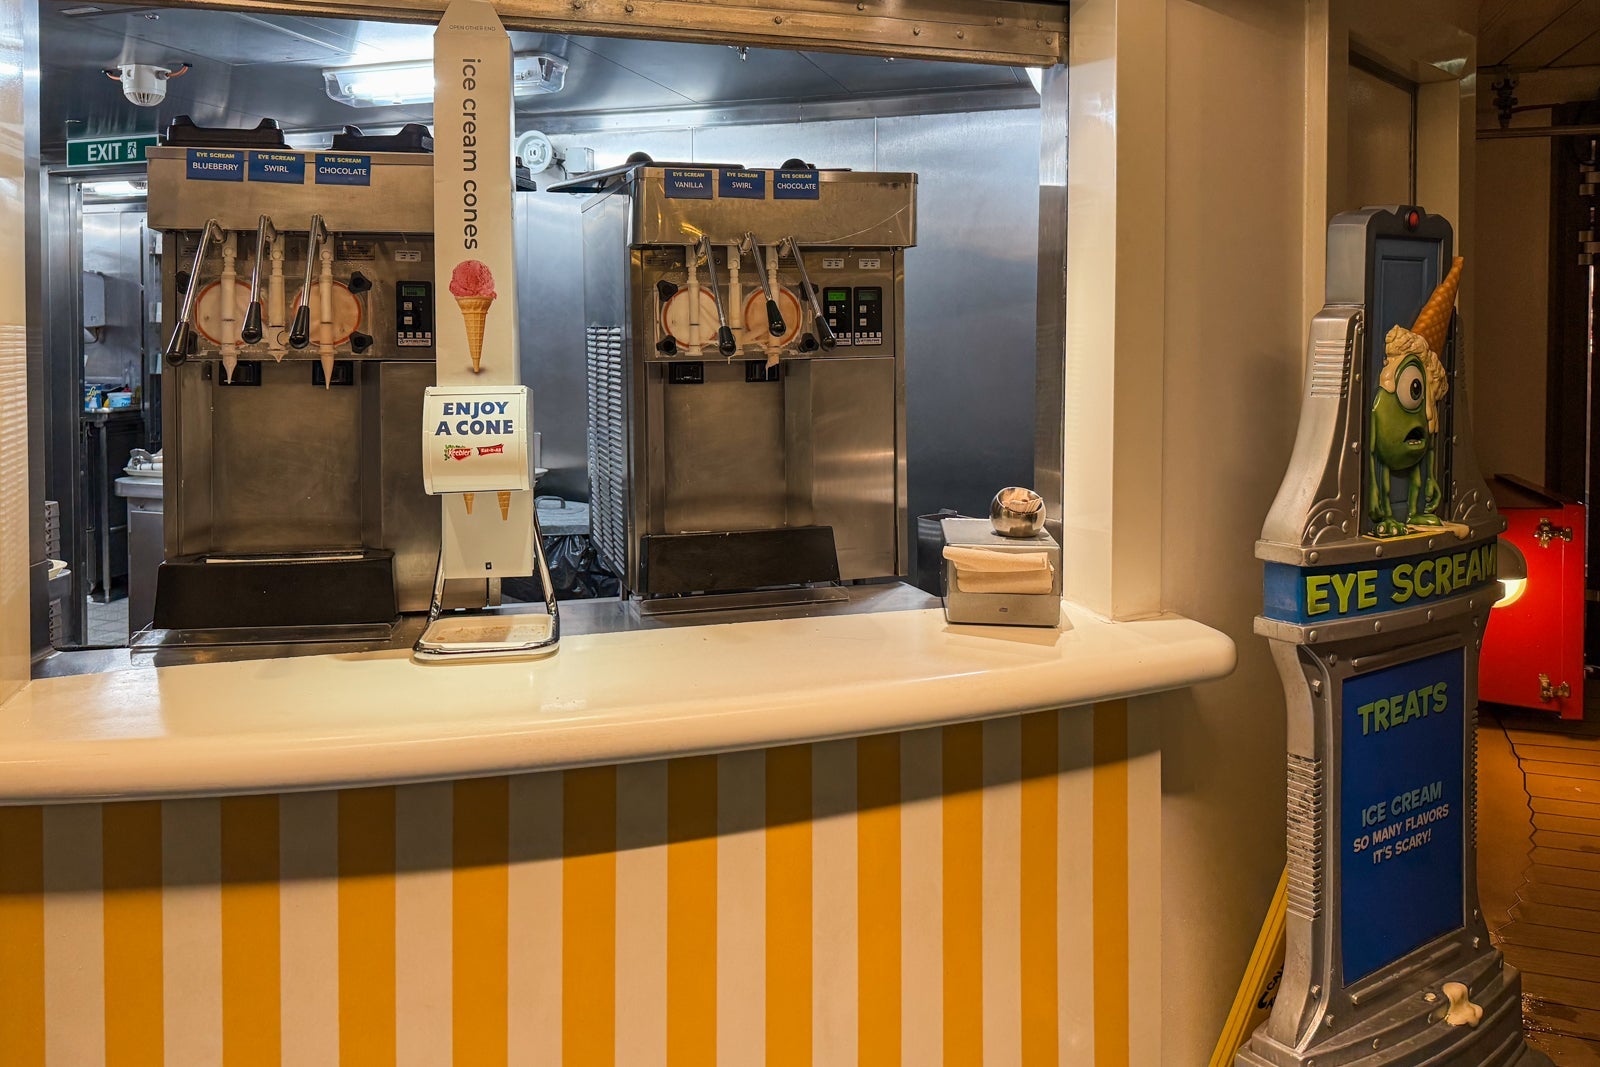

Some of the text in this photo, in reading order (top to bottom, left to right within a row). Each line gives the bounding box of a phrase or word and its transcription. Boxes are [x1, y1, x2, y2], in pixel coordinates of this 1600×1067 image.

[87, 142, 122, 162] EXIT
[462, 58, 481, 250] ice cream cones
[192, 161, 239, 171] BLUEBERRY
[264, 164, 289, 173] SWIRL
[319, 166, 367, 176] CHOCOLATE
[674, 181, 704, 189] VANILLA
[731, 181, 752, 189] SWIRL
[776, 182, 817, 190] CHOCOLATE
[443, 401, 509, 419] ENJOY
[434, 419, 514, 436] A CONE
[1306, 543, 1498, 616] EYE SCREAM
[1357, 681, 1448, 736] TREATS
[1361, 781, 1443, 828] ICE CREAM
[1353, 803, 1450, 853] SO MANY FLAVORS
[1372, 828, 1432, 865] IT'S SCARY!
